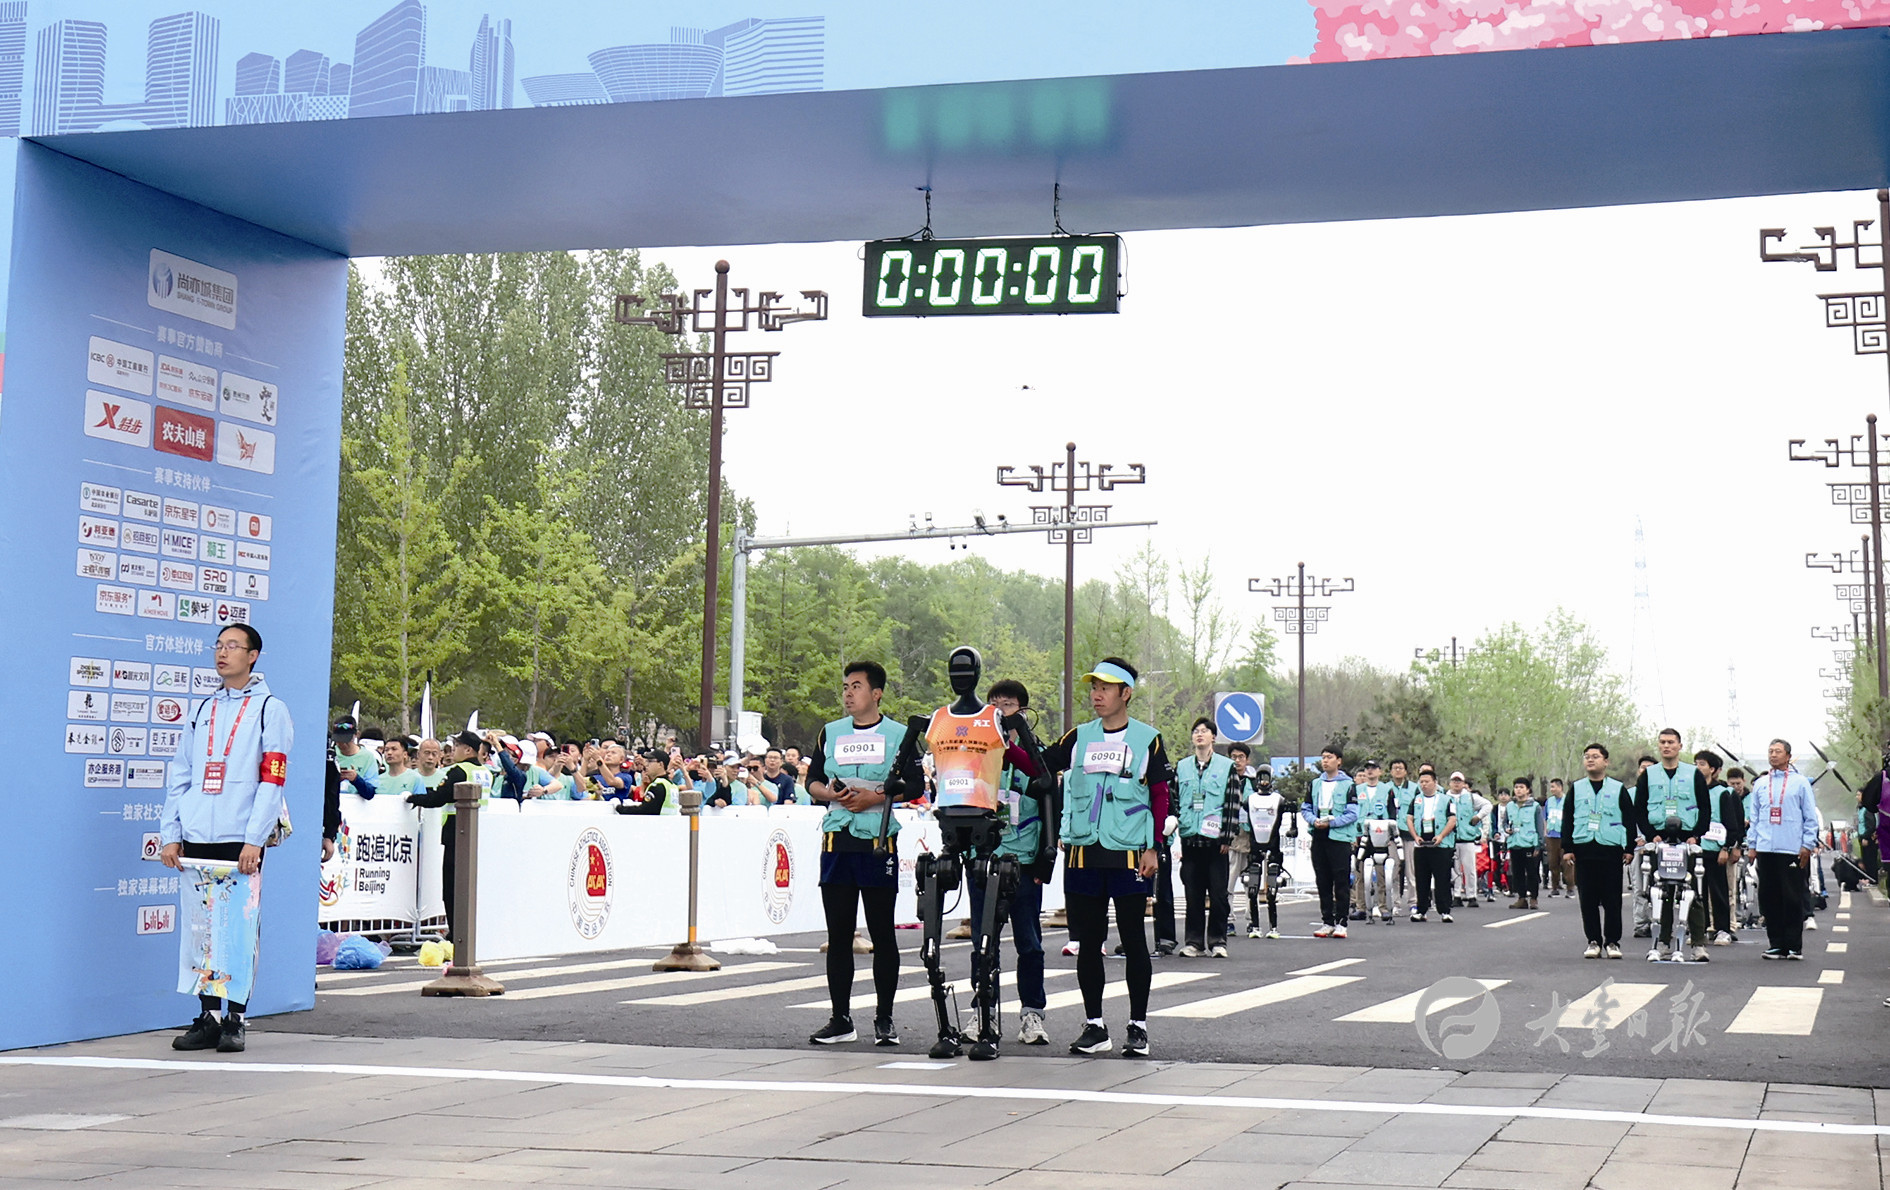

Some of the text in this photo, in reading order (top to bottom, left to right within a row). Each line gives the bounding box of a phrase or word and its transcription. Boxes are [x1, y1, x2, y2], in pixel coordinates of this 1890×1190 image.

[876, 245, 1104, 307] 0:00:00
[178, 272, 234, 304] 尚亦城集团
[90, 352, 105, 363] ICBC
[117, 416, 142, 434] 特步
[162, 422, 206, 449] 农夫山泉
[154, 467, 210, 492] 赛事支持伙伴
[126, 495, 158, 508] Casarte
[164, 504, 197, 521] 京东星宇
[94, 525, 115, 536] 利亚德
[207, 541, 226, 559] 狮王
[203, 570, 228, 582] SRO
[203, 583, 215, 592] GT
[191, 601, 209, 619] 蒙牛
[230, 606, 247, 619] 迈胜
[146, 634, 203, 655] 官方体验伙伴
[128, 671, 149, 682] 晨光文具
[843, 744, 875, 753] 60901
[1091, 752, 1122, 762] 60901
[88, 763, 121, 775] 亦企服务港
[123, 803, 163, 820] 独家社交
[356, 834, 412, 863] 跑遍北京
[360, 867, 390, 880] Running
[117, 877, 178, 896] 独家弹幕视频
[359, 881, 385, 894] Beijing
[144, 909, 170, 931] bilibili
